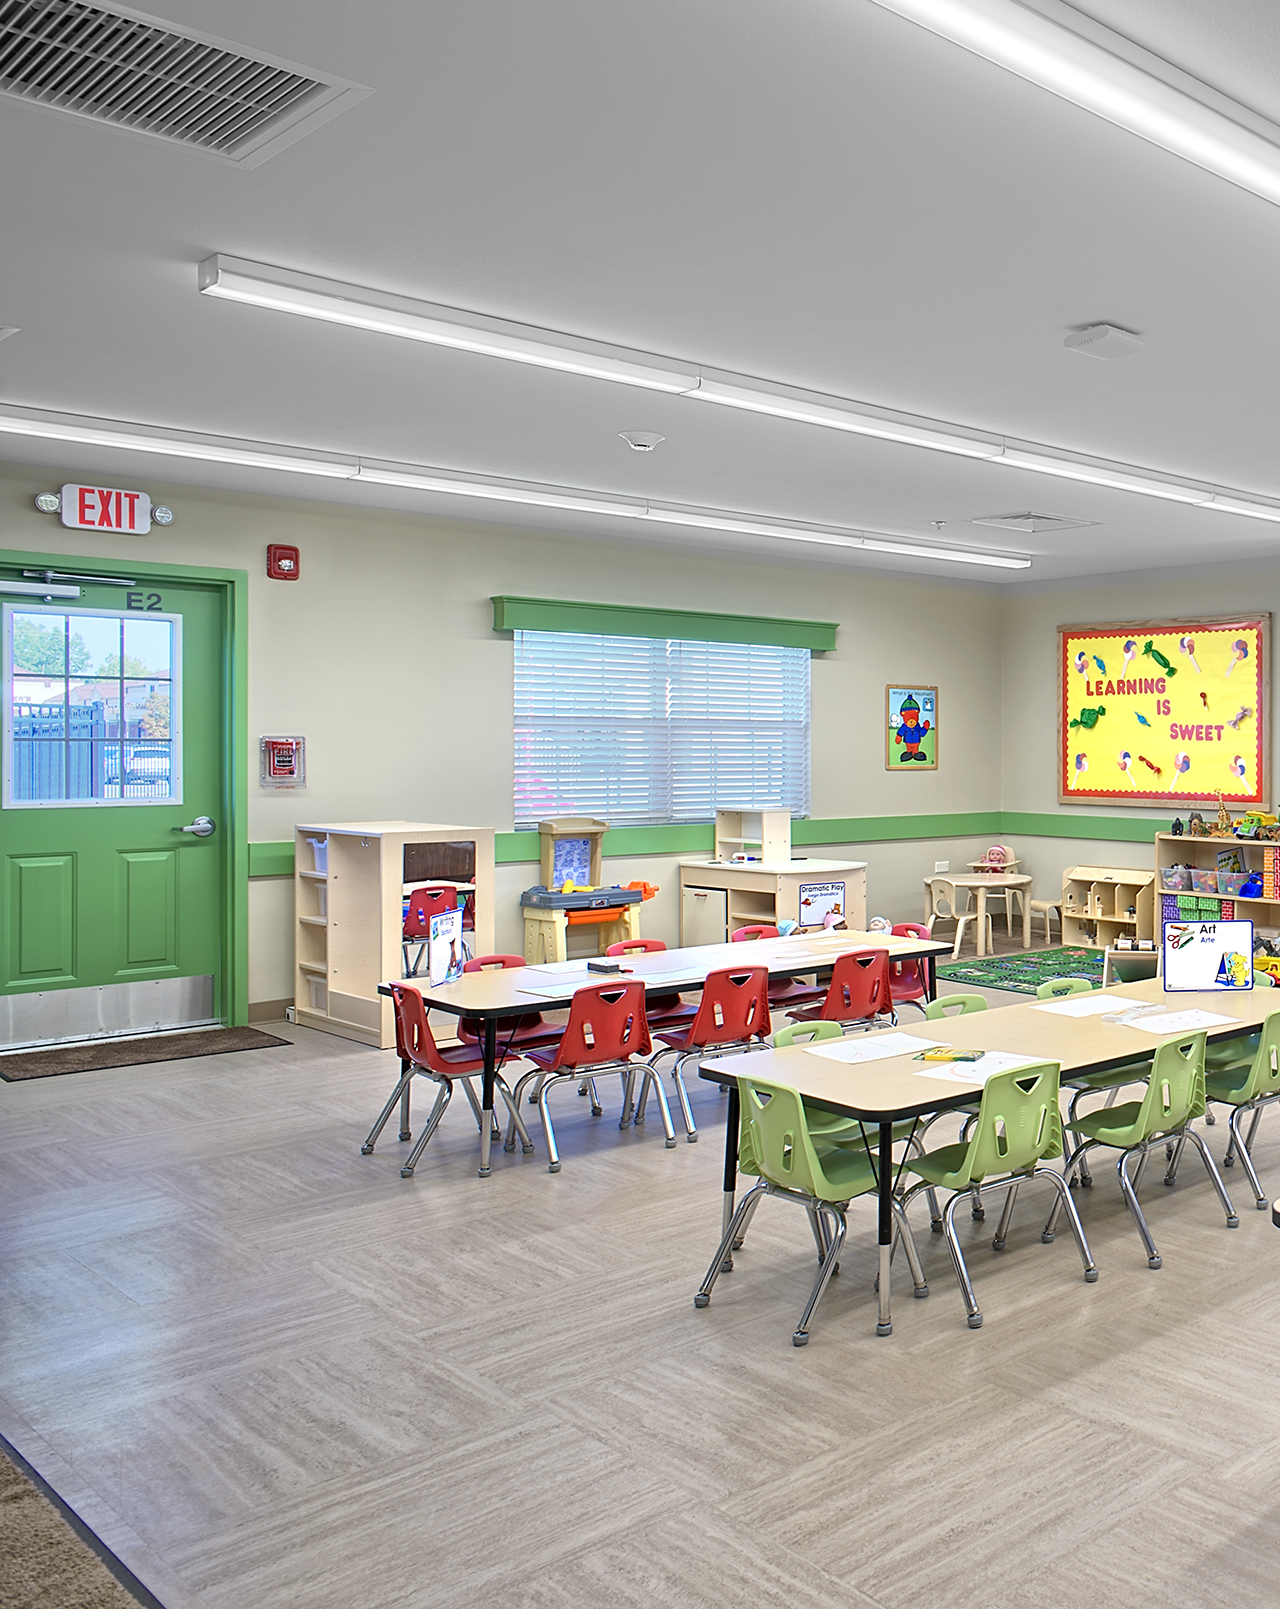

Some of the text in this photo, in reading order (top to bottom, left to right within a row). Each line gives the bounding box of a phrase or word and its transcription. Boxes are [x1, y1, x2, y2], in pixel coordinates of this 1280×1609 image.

[78, 487, 140, 530] EXIT
[126, 592, 163, 611] E2
[1086, 677, 1166, 696] LEARNING
[1157, 699, 1171, 716] IS
[1170, 723, 1224, 741] SWEET
[1200, 924, 1217, 934] Art
